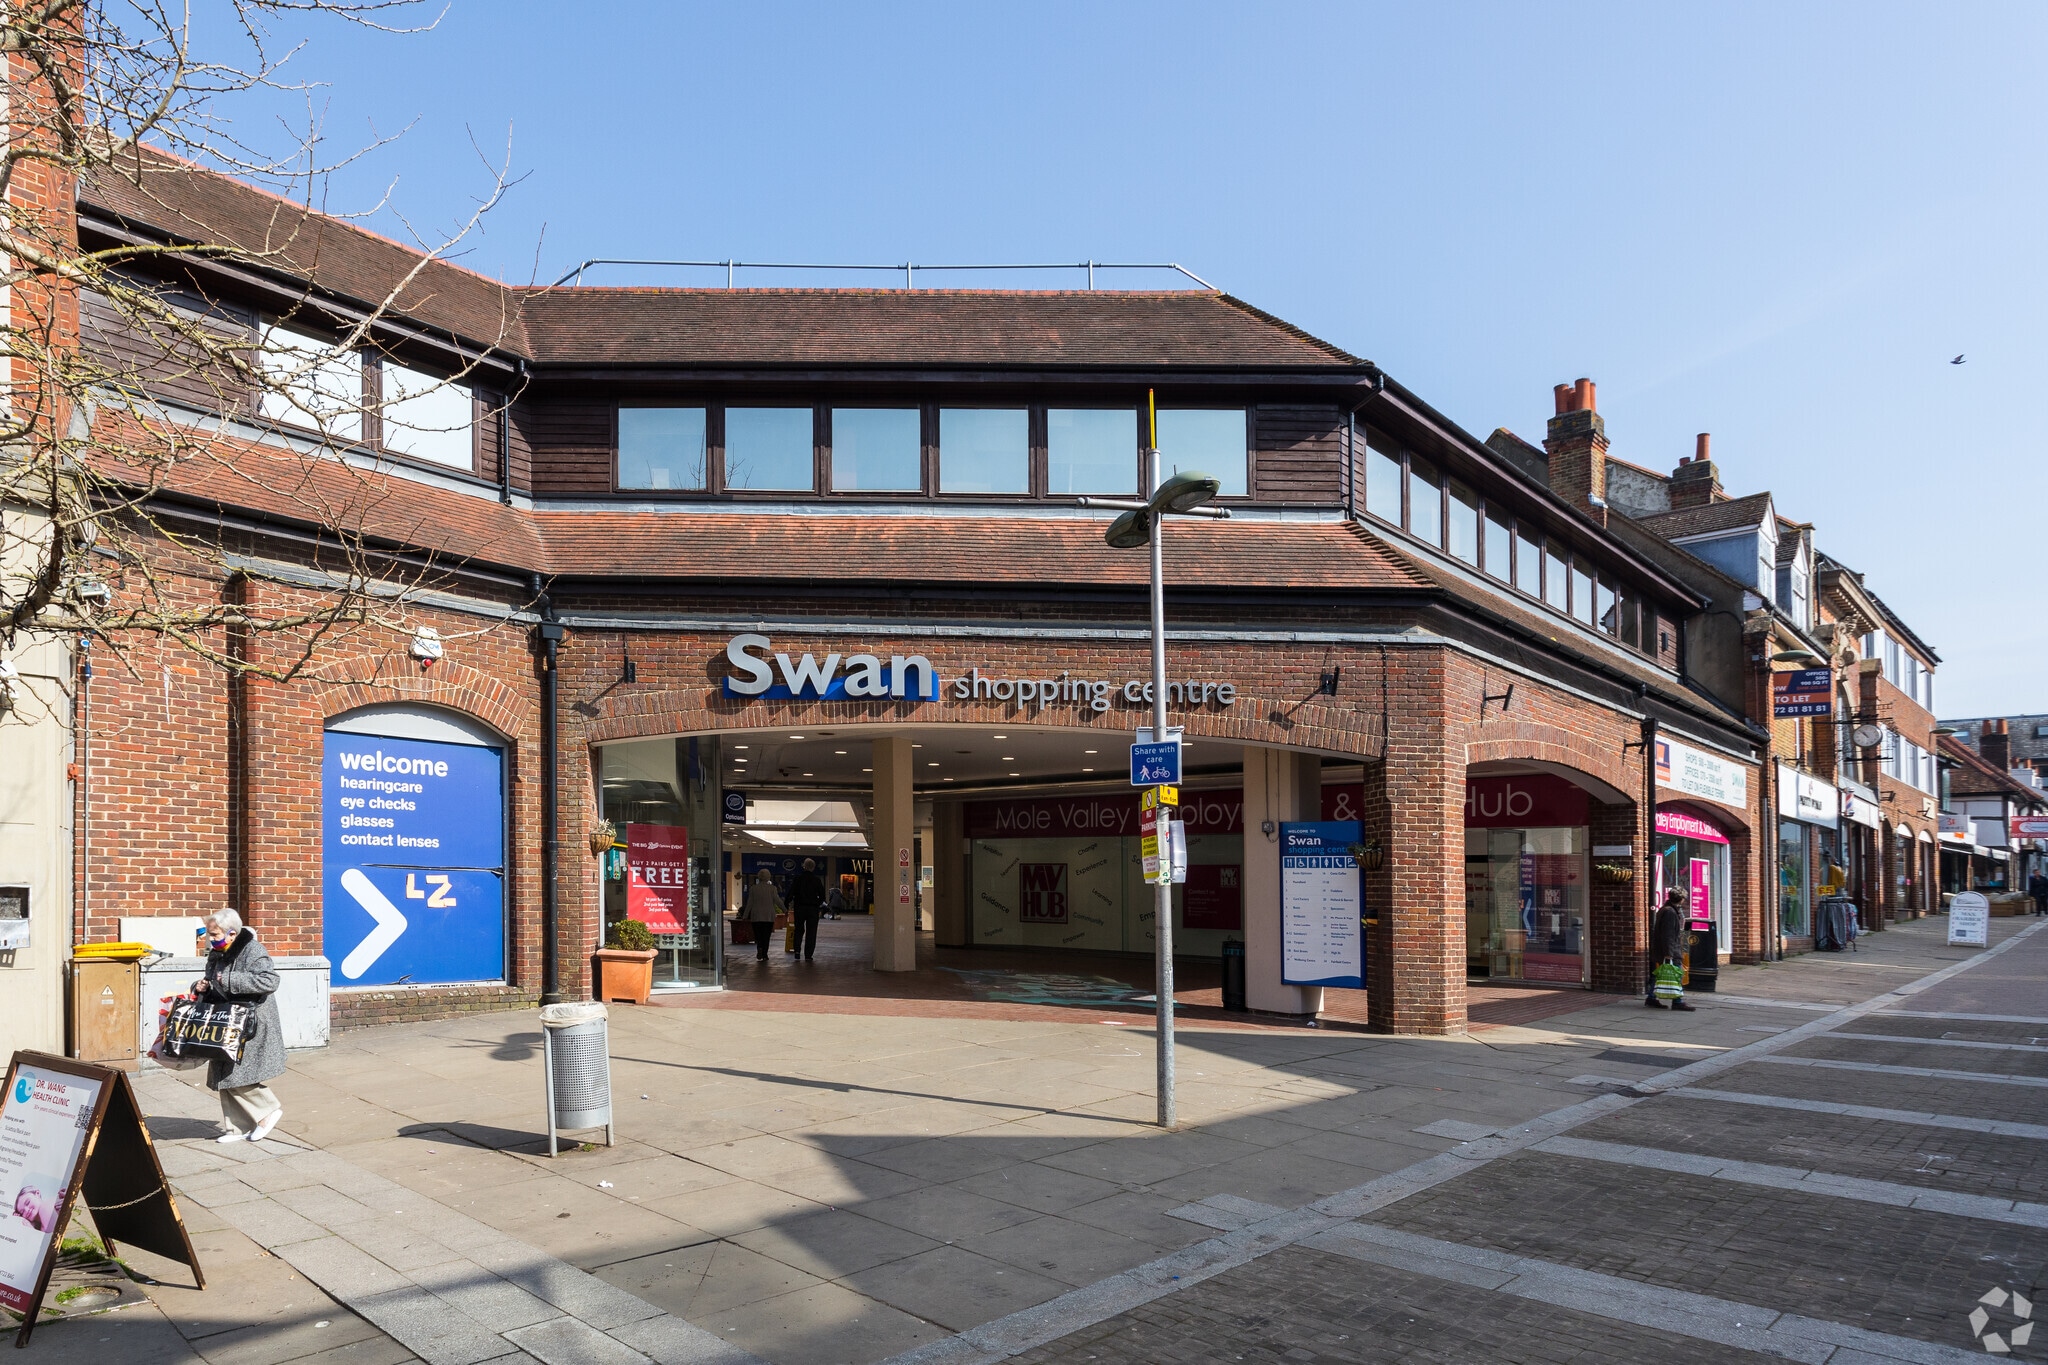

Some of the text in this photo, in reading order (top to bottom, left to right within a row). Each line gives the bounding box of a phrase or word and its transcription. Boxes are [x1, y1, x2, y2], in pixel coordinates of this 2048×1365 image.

[727, 634, 1235, 711] Swan shopping centre
[1134, 747, 1157, 755] Share
[340, 751, 448, 777] welcome
[340, 776, 423, 793] hearingcare
[340, 796, 416, 811] eye checks
[725, 813, 745, 822] Opticians
[996, 804, 1050, 830] Mole
[1058, 801, 1130, 833] Valley
[1333, 793, 1358, 821] &
[340, 814, 394, 828] glasses
[1142, 821, 1157, 832] PARKING
[1655, 813, 1669, 832] alley
[1669, 813, 1699, 835] Employment
[340, 834, 440, 848] contact lenses
[1288, 835, 1321, 846] Swan
[1078, 843, 1098, 855] Change
[1289, 846, 1325, 855] shopping
[1075, 859, 1107, 876] Experience
[1132, 855, 1143, 866] So
[632, 866, 684, 884] FREE
[1022, 865, 1064, 891] MV
[981, 892, 1010, 914] Guidance
[1092, 888, 1113, 906] Learning
[1023, 891, 1065, 918] HUB
[1073, 912, 1104, 926] Community
[1140, 911, 1156, 922] Emp
[36, 1079, 66, 1093] DR. WANG
[32, 1091, 70, 1107] HEALTH CLINIC
[58, 1110, 76, 1119] experience
[0, 1144, 27, 1157] igraine/Headache
[0, 1287, 22, 1304] ure.co.uk
